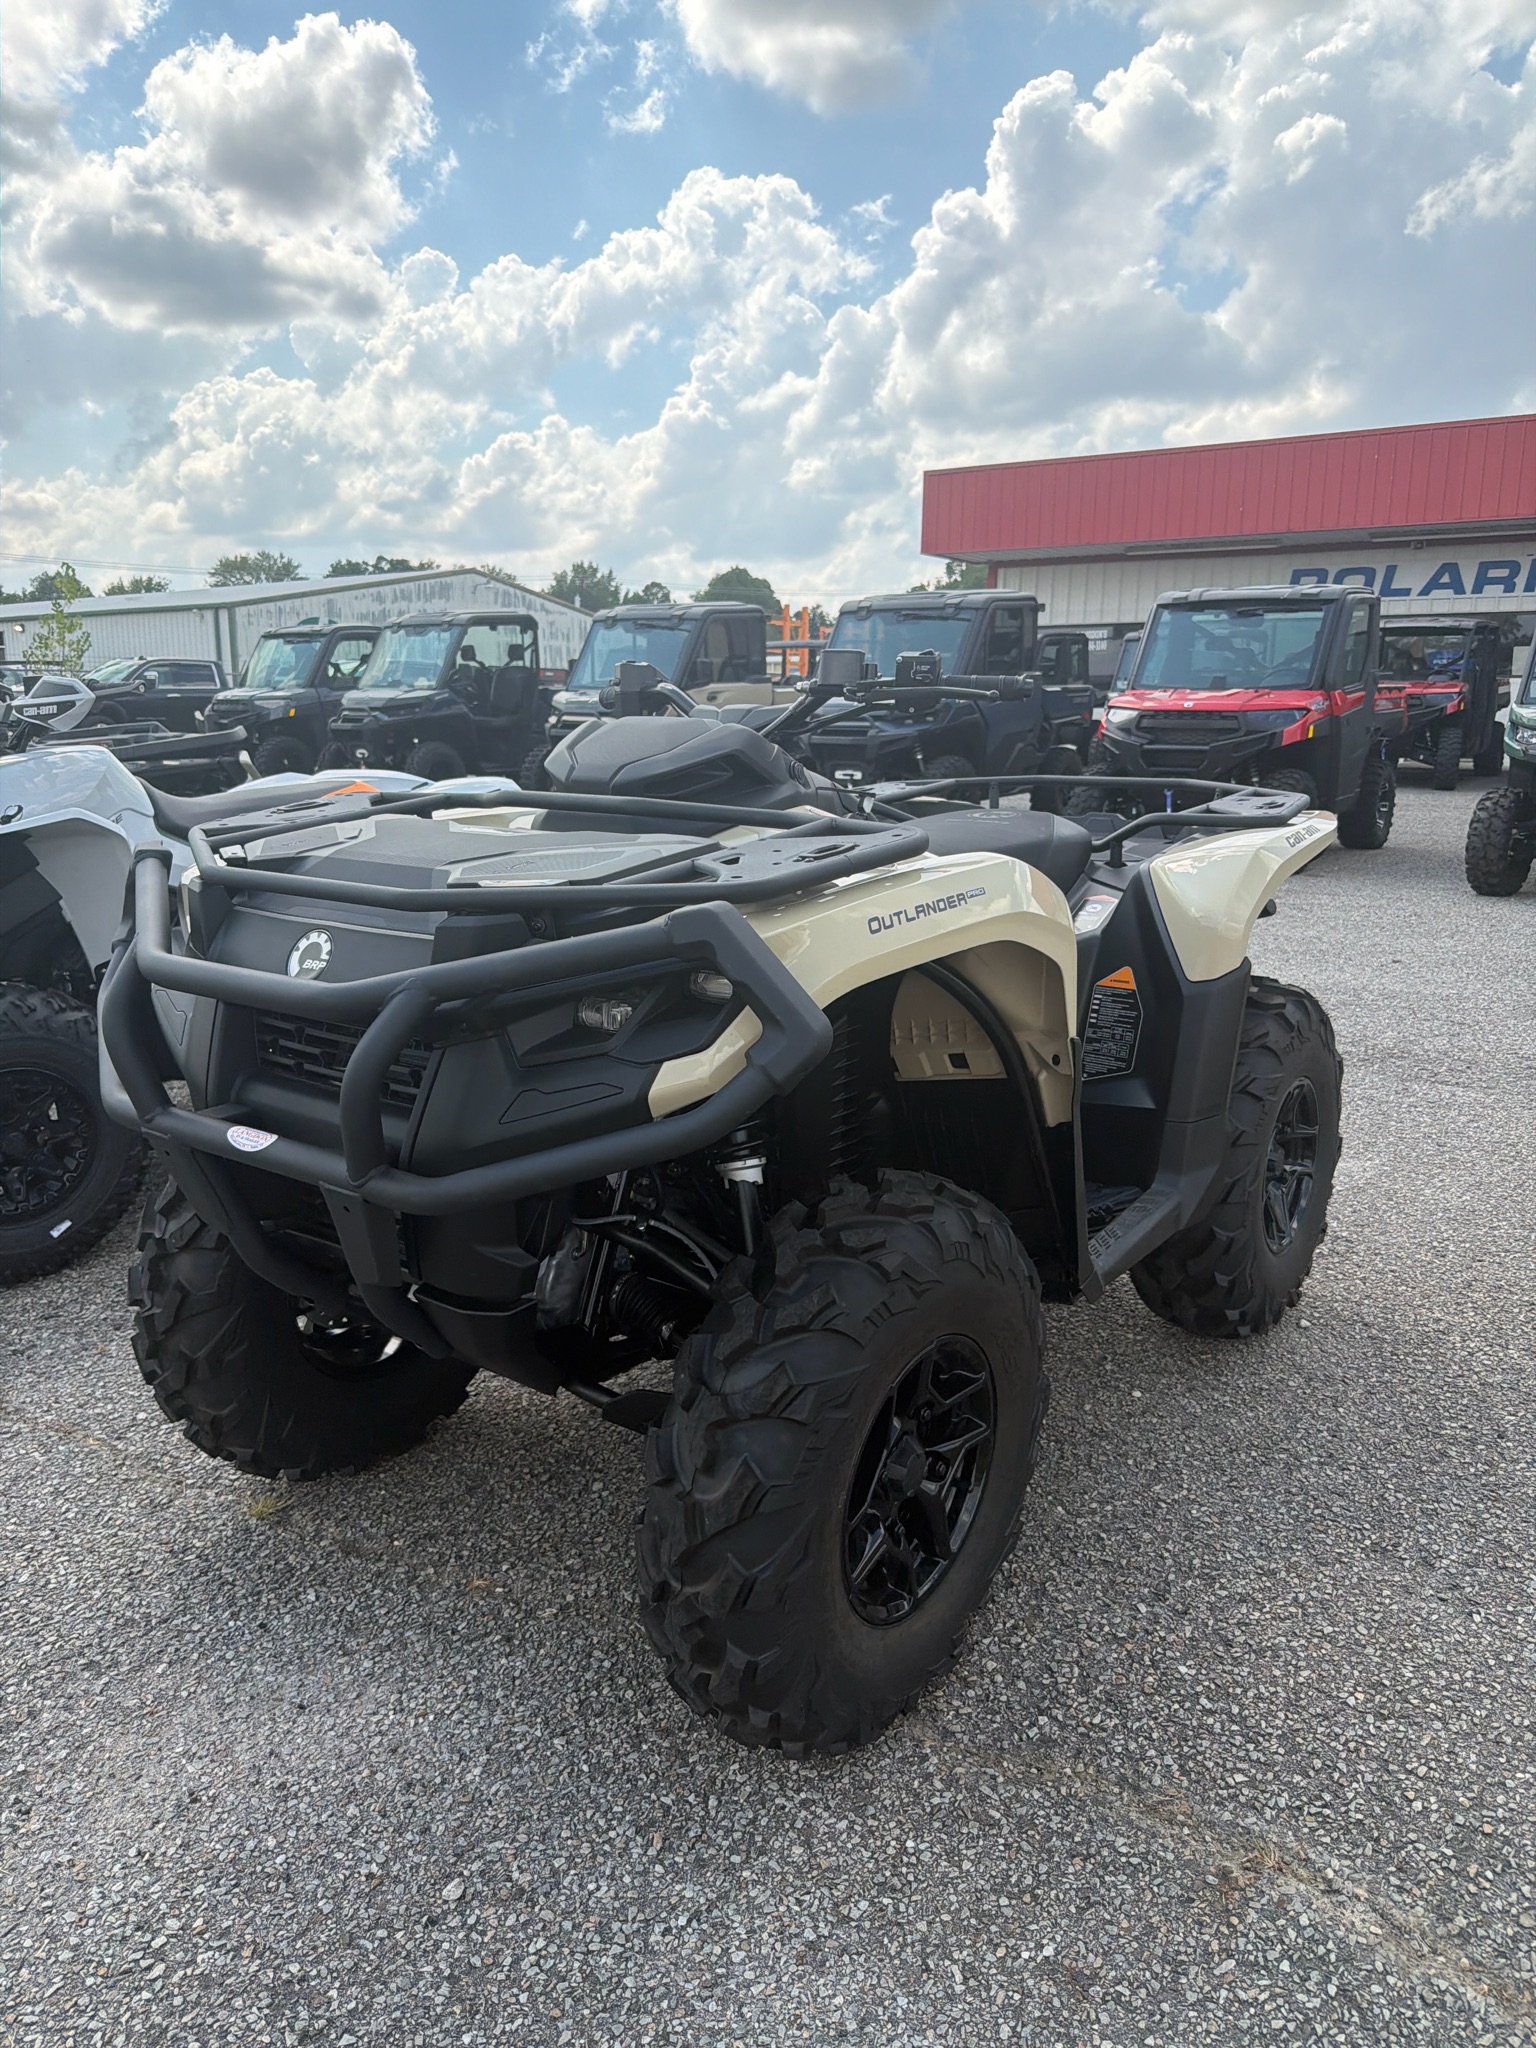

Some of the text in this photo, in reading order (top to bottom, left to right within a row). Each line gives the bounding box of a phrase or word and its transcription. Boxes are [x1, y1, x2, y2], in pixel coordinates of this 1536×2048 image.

[23, 705, 57, 716] can-am
[1285, 824, 1320, 848] can-am
[867, 887, 986, 935] OUTLANDER PRO
[302, 959, 327, 970] BRP
